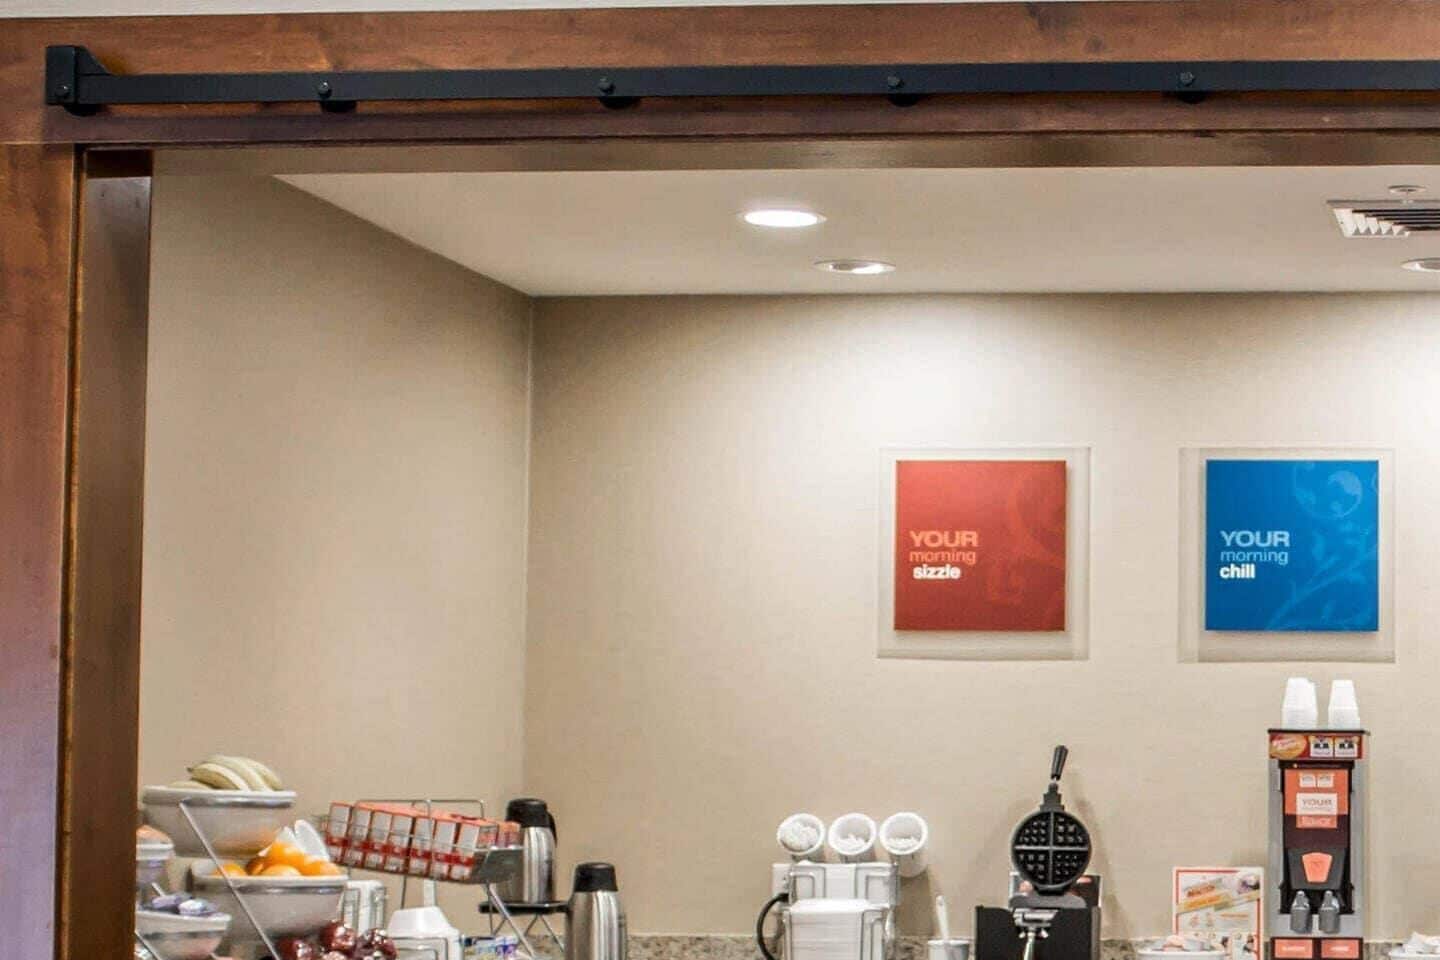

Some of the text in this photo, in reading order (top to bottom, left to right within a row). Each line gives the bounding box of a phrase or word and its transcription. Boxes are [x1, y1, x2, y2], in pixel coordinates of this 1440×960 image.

[909, 530, 978, 548] YOUR
[1220, 530, 1290, 548] YOUR
[909, 549, 976, 566] morning
[1220, 549, 1289, 566] morning
[912, 563, 962, 580] sizzle
[1219, 563, 1256, 580] chill
